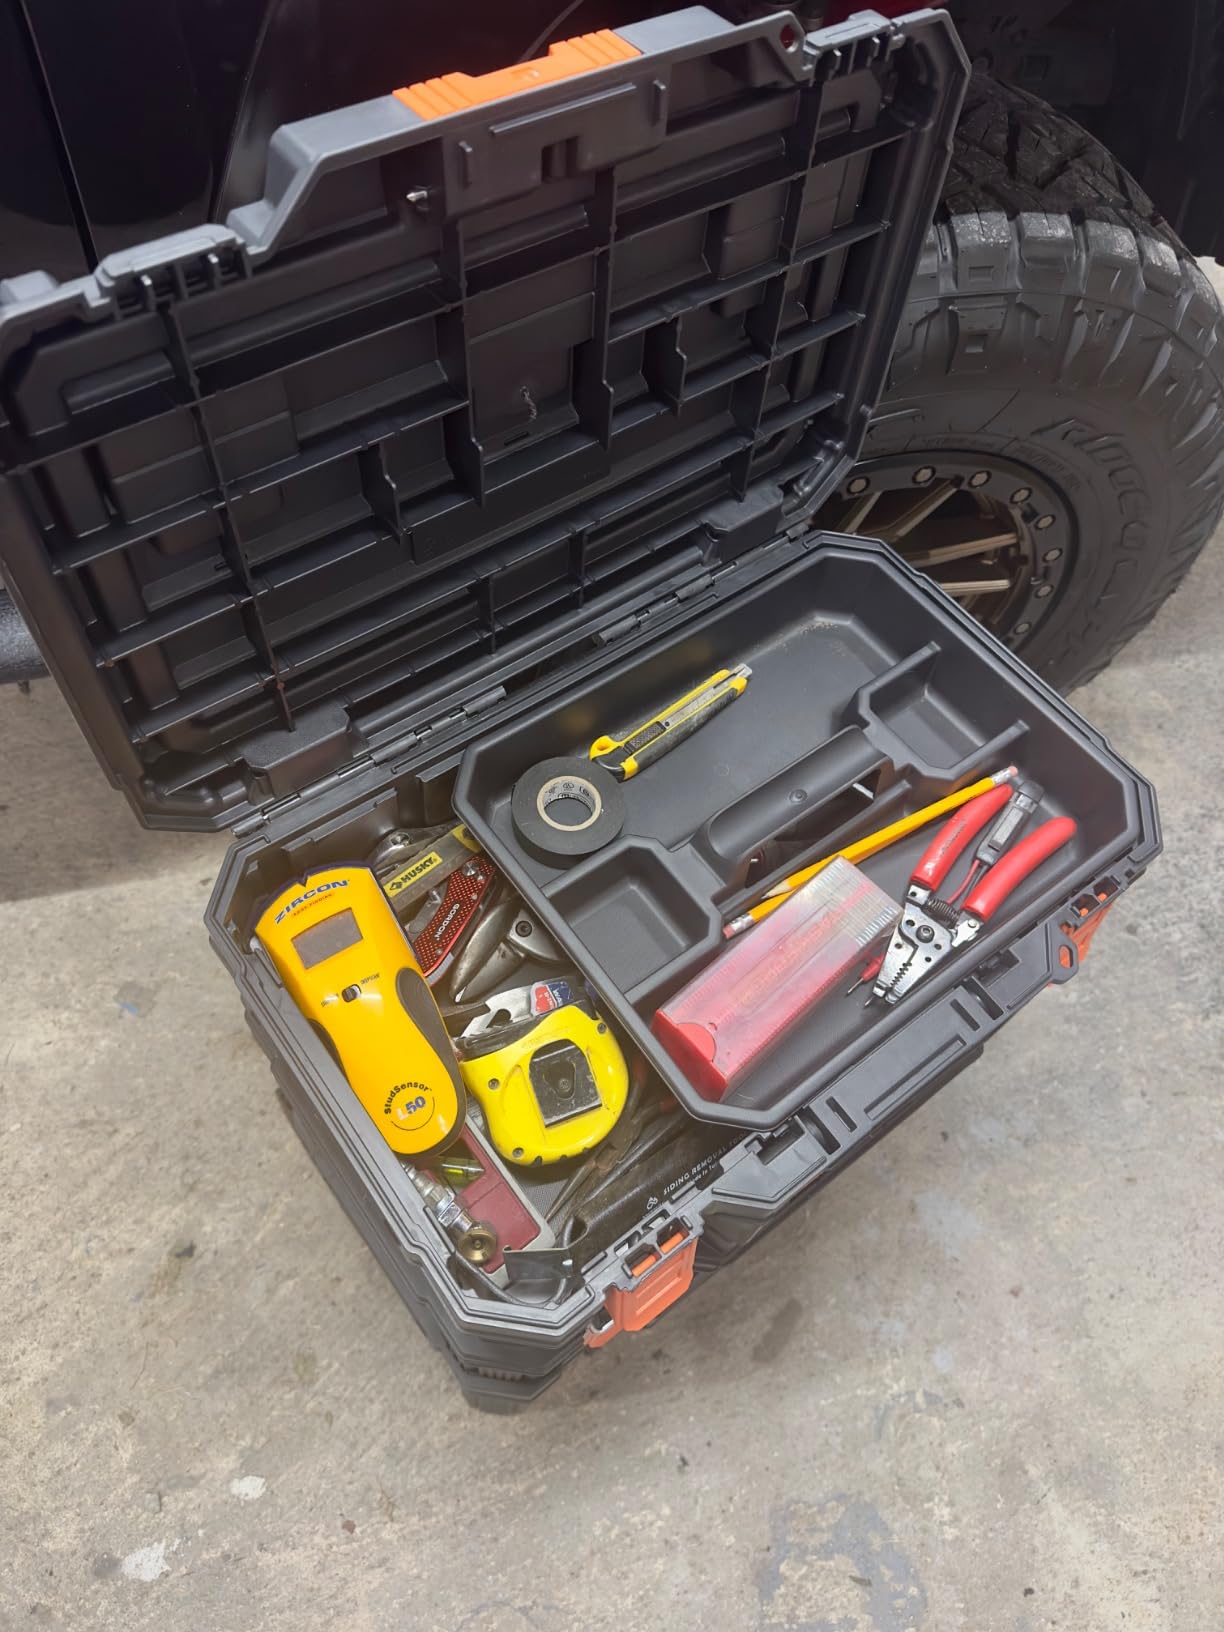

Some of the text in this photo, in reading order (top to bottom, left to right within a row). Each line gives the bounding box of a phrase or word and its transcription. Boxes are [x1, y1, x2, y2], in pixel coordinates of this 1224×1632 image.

[400, 857, 434, 883] HUSKY
[274, 879, 349, 925] ZIRCON
[434, 903, 460, 938] GORDON
[384, 1081, 430, 1115] StudSensor
[397, 1095, 426, 1121] L50
[663, 1172, 690, 1196] SIDING
[691, 1146, 729, 1176] REMOVAL
